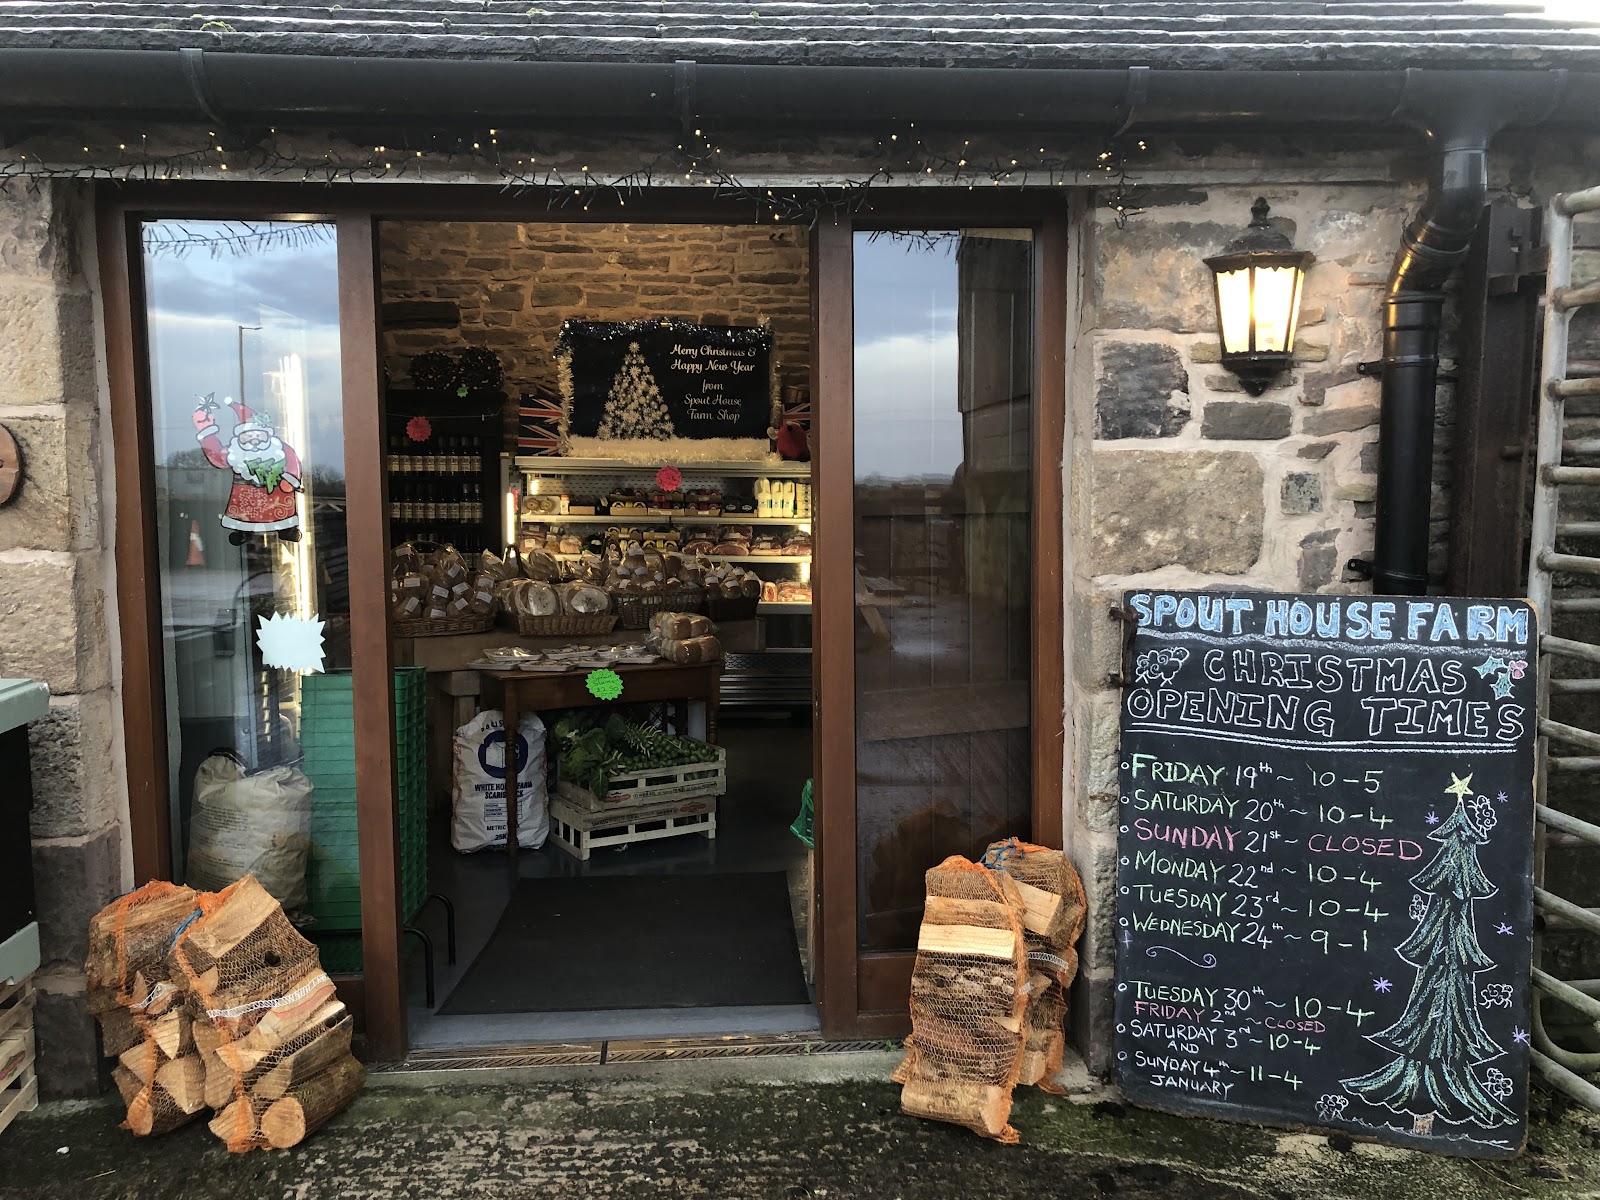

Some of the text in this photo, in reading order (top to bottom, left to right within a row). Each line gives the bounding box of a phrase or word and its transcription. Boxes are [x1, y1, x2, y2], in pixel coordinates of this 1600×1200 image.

[670, 344, 756, 358] Merry Christmas &
[671, 359, 755, 375] Happy New Year
[684, 394, 742, 407] Spout House
[702, 378, 724, 393] from
[717, 409, 740, 424] Shop
[1130, 594, 1528, 644] SPOUT HOUSE FARM
[1203, 649, 1467, 694] CHRISTMAS
[1127, 689, 1525, 740] OPENING TIMES
[1132, 754, 1225, 783] FRIDAY
[1235, 763, 1273, 788] 19th
[1133, 789, 1239, 821] SATURDAY
[1244, 798, 1284, 822] 20th
[1135, 818, 1242, 852] SUNDAY
[1244, 829, 1281, 853] 21st
[1308, 834, 1422, 860] CLOSED
[1135, 851, 1228, 884] MONDAY
[1228, 862, 1274, 888] 22nd
[1133, 884, 1228, 916] TUESDAY
[1230, 893, 1279, 917] 23rd
[1132, 912, 1239, 943] WEDNESDAY
[1240, 922, 1283, 948] 24th
[1129, 980, 1219, 1009] TUESDAY
[1223, 985, 1264, 1011] 30th
[1130, 1019, 1218, 1044] SATURDAY
[1134, 1001, 1205, 1024] FRIDAY
[1264, 1018, 1326, 1032] CLOSED
[1168, 1040, 1199, 1053] AND
[1135, 1050, 1208, 1075] SUNDAY
[1150, 1074, 1234, 1099] JANUARY
